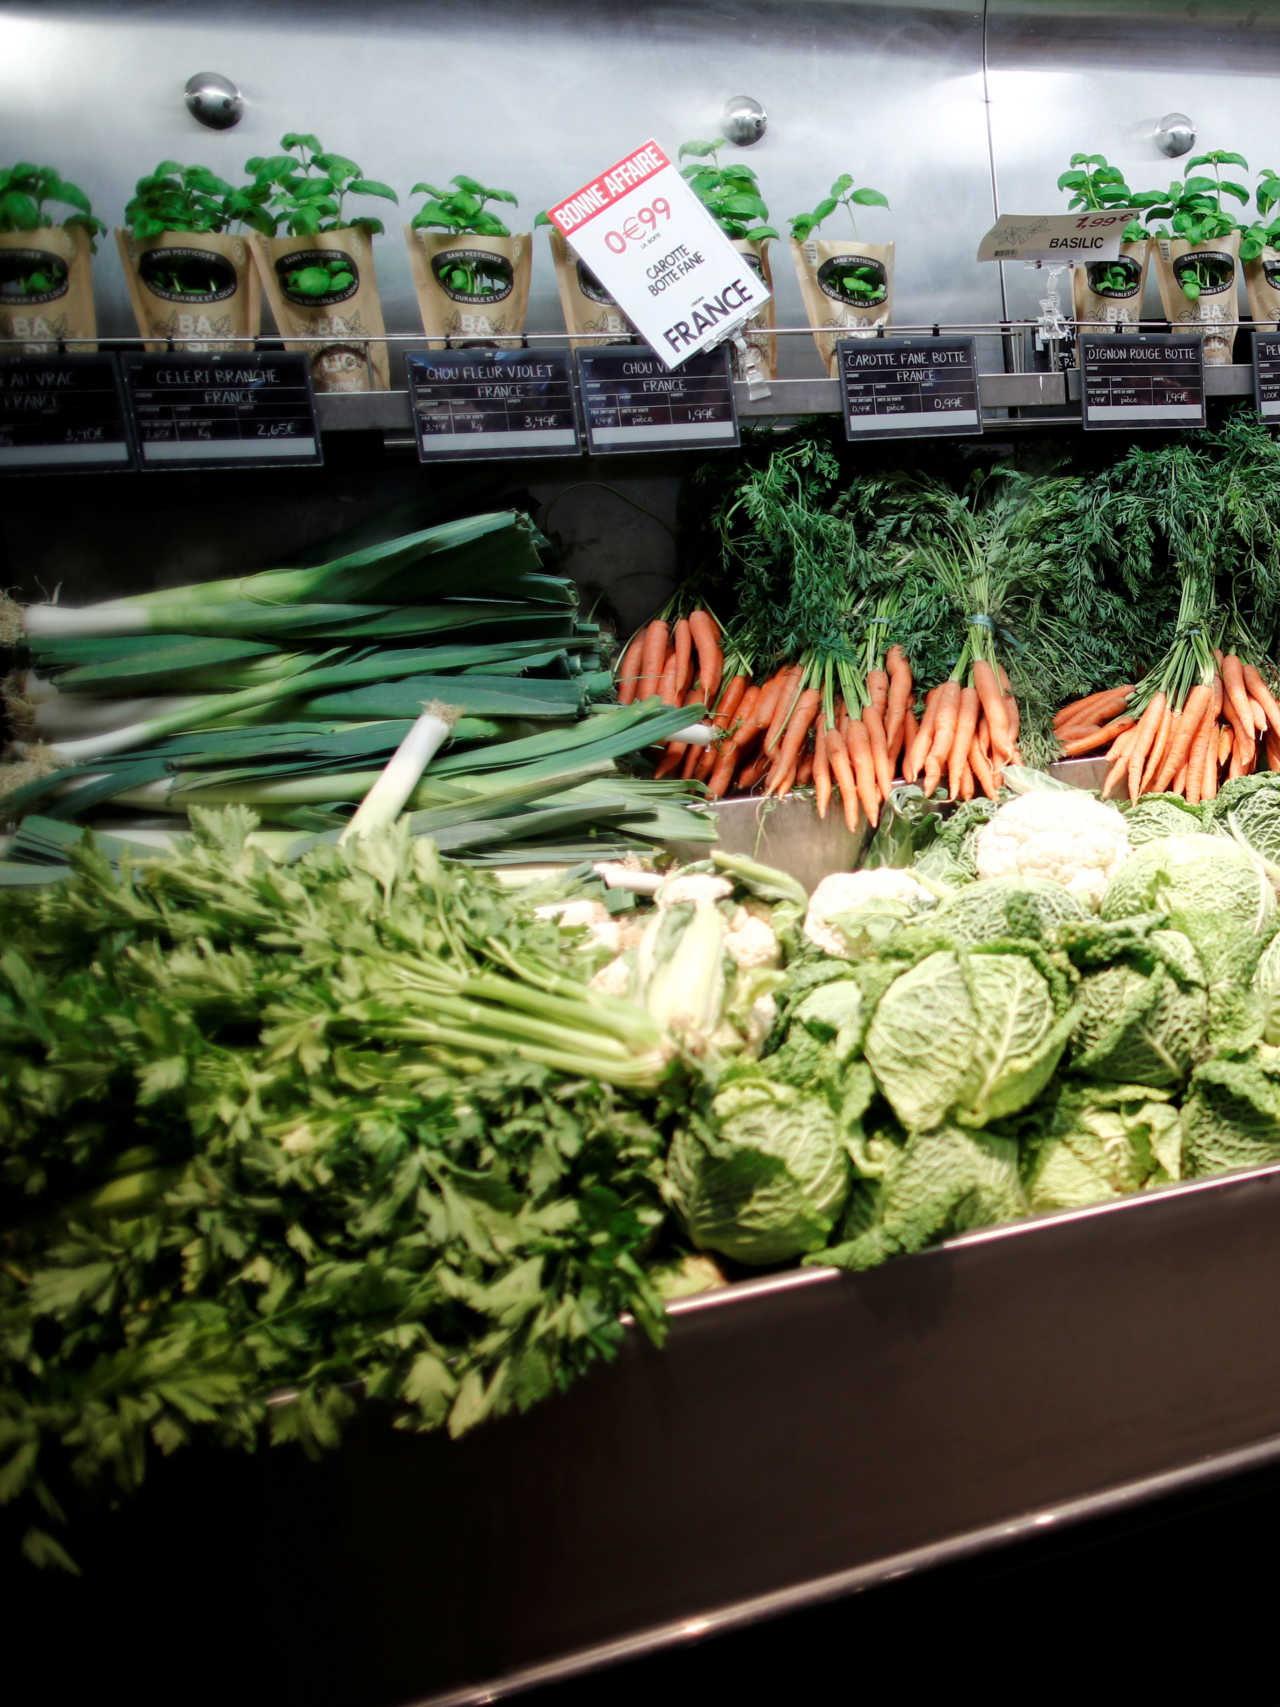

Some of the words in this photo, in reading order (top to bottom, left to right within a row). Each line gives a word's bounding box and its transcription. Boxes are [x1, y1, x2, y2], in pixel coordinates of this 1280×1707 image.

[553, 183, 610, 231] BONNE
[602, 146, 664, 197] AFFAIRE
[604, 197, 671, 254] 0€99
[1076, 213, 1133, 229] 1,99€
[1049, 237, 1104, 249] BASILIC
[646, 244, 690, 280] CAROTTE
[648, 268, 680, 296] BOTTE
[676, 251, 705, 276] FANE
[663, 279, 753, 353] FRANCE
[1200, 304, 1224, 319] BA
[178, 314, 211, 333] BA
[847, 352, 897, 367] CAROTTE
[900, 351, 929, 365] FANE
[932, 350, 968, 364] BOTTE
[1087, 347, 1127, 360] OIGNON
[1129, 347, 1161, 360] ROUGE
[1164, 347, 1197, 360] BOTTE
[155, 369, 209, 384] CELERI
[215, 368, 280, 384] BRANCHE
[426, 366, 459, 380] CHOU
[463, 365, 503, 380] FLEUR
[507, 364, 553, 378] VIOLET
[622, 362, 653, 375] CHOU
[896, 370, 937, 382] FRANCE
[477, 384, 524, 399] FRANCE
[642, 379, 688, 393] FRANCE
[203, 391, 257, 404] FRANCE
[933, 396, 963, 410] 0,99€
[1166, 391, 1189, 403] 1,99€
[687, 408, 715, 422] 1,99€
